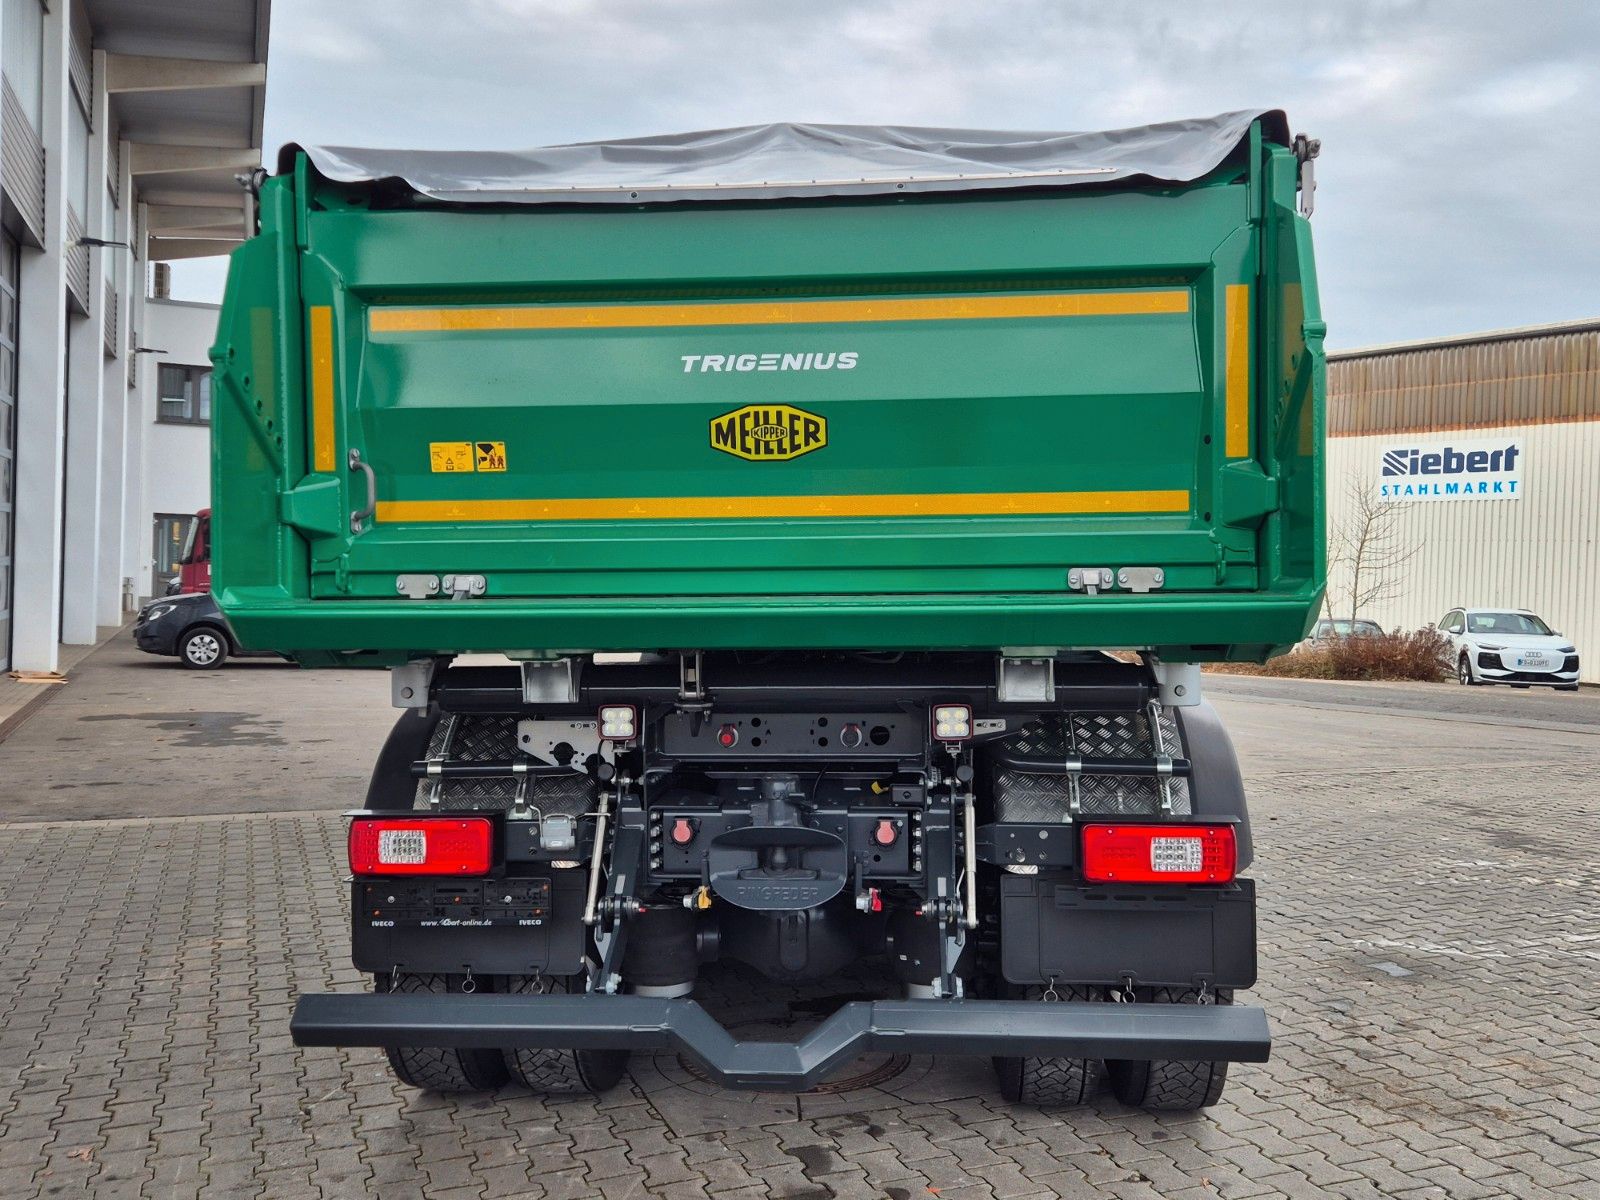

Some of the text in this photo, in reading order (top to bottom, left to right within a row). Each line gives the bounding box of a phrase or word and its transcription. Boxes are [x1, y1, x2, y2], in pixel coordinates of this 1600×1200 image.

[681, 352, 859, 373] TRIGENIUS
[714, 410, 821, 455] MEILLER
[753, 426, 785, 440] KIPPER
[1382, 444, 1520, 477] Siebert
[1381, 480, 1518, 497] STAHLMARKT
